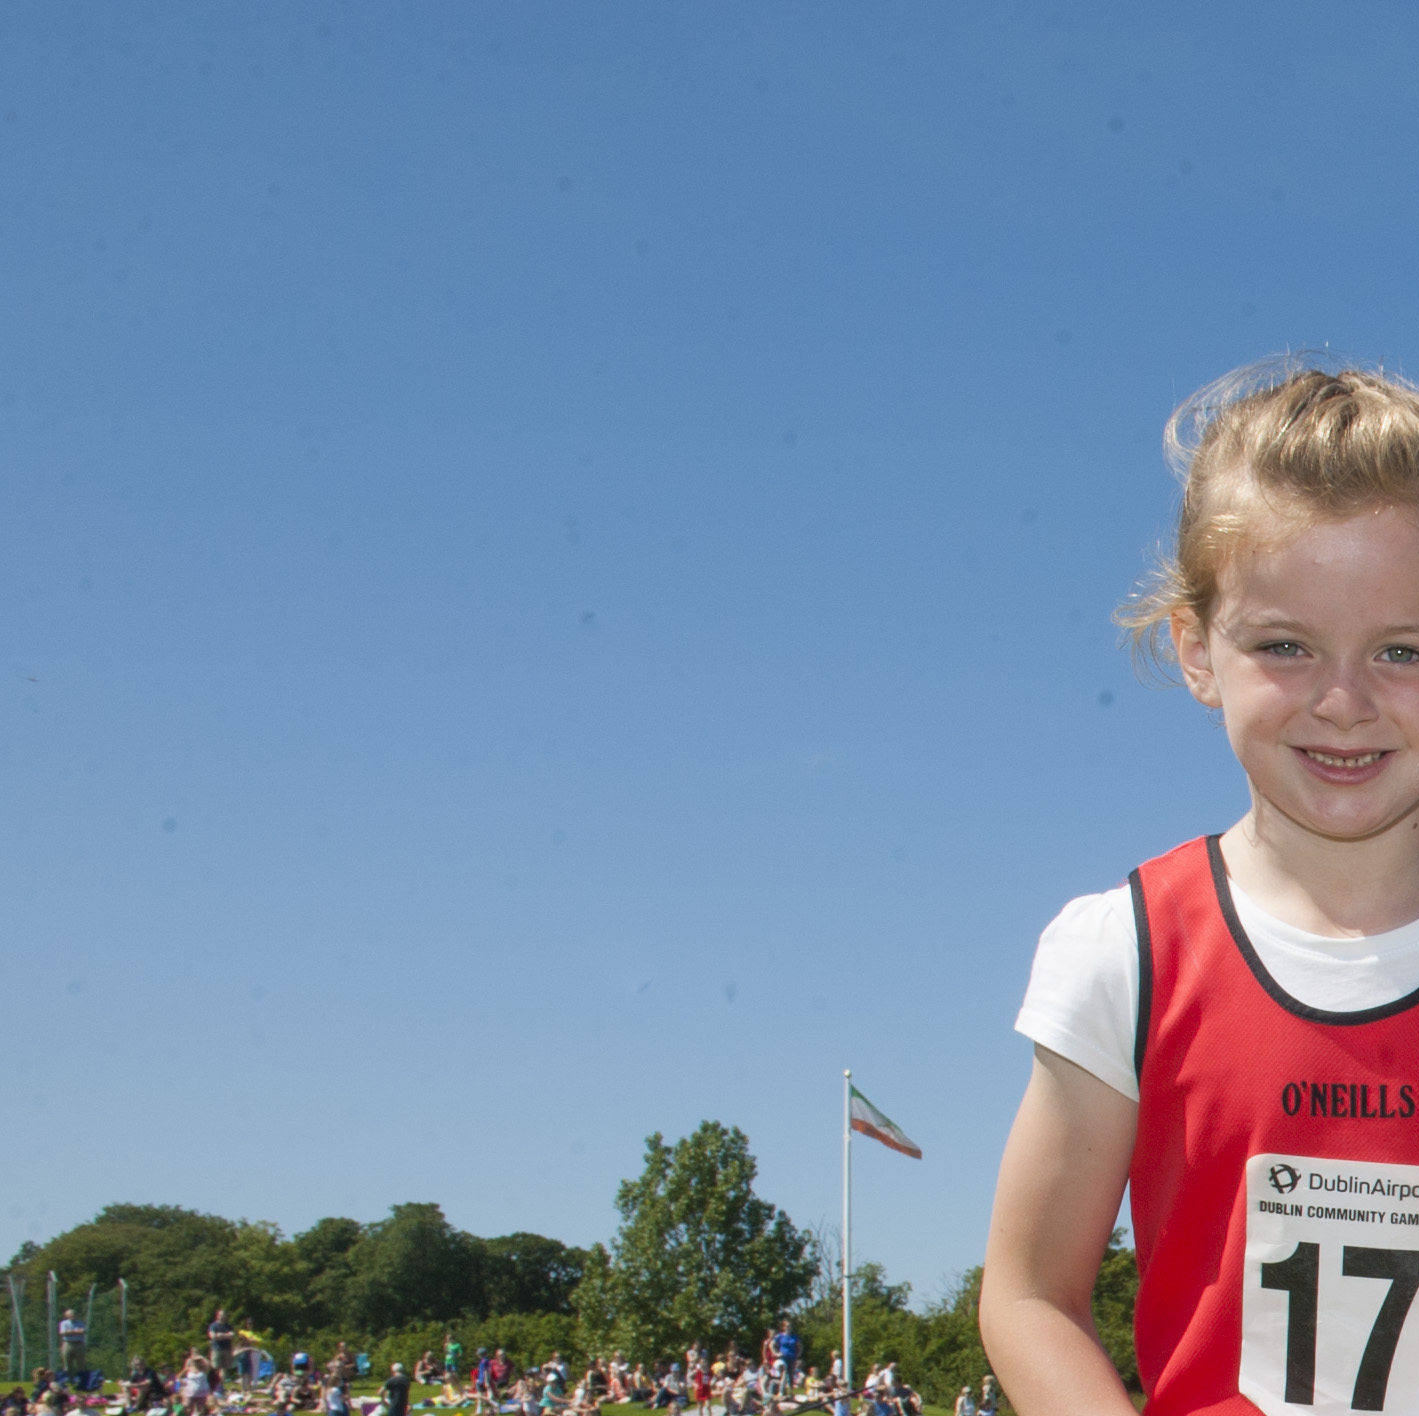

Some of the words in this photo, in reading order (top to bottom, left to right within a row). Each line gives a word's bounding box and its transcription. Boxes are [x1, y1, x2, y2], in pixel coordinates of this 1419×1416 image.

[1281, 1081, 1416, 1118] O'NEILLS
[1259, 1200, 1303, 1217] DUBLIN
[1307, 1205, 1386, 1224] COMMUNITY
